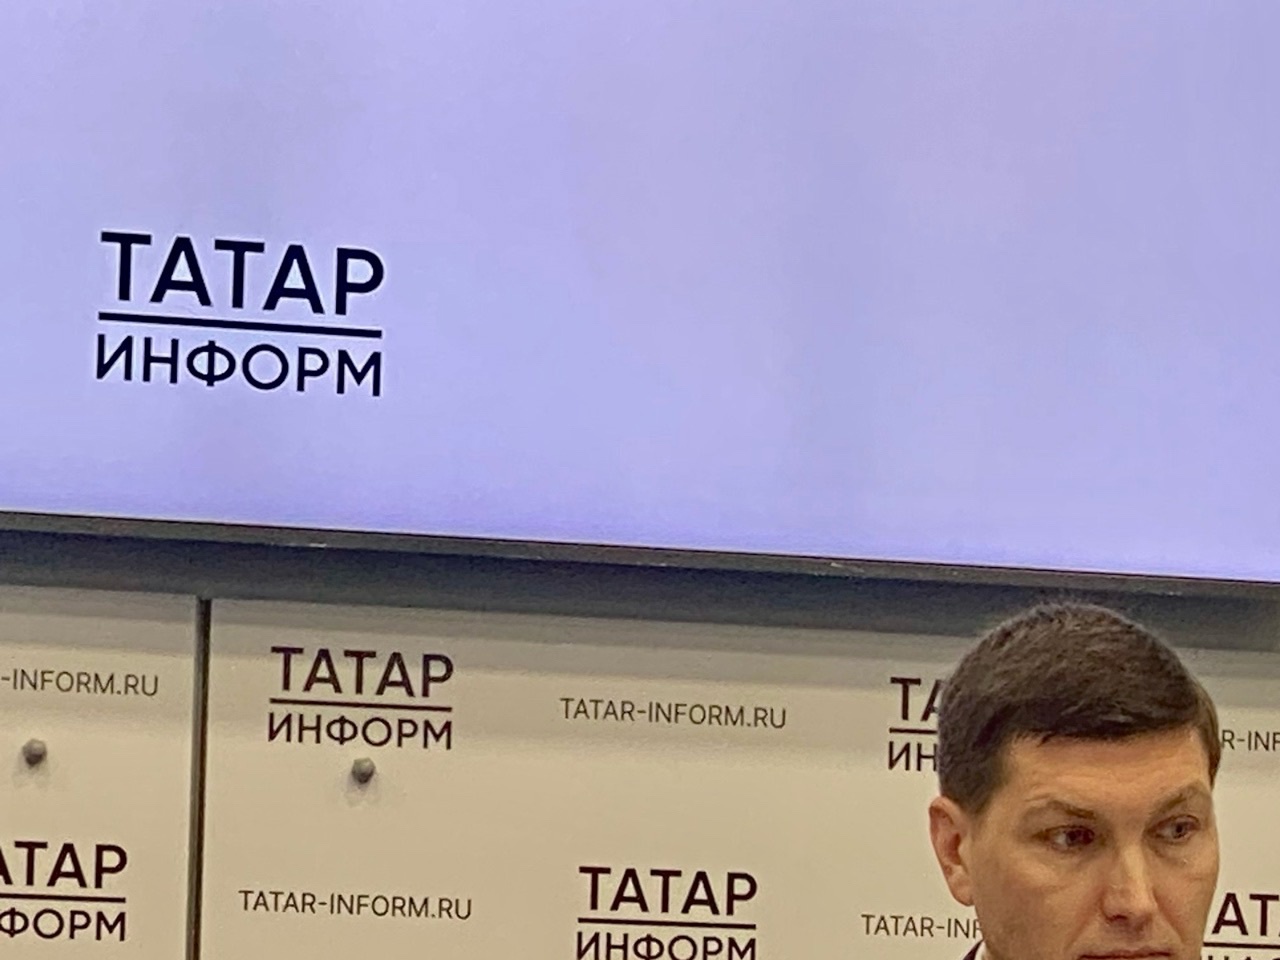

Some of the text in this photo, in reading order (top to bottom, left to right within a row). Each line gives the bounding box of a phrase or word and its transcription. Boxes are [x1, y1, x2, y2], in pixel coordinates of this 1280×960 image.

[101, 231, 384, 315] ТАТАР
[96, 334, 383, 397] ИНФОРМ
[269, 645, 454, 699] ТАТАР
[268, 711, 453, 750] ИНФОРМ
[560, 697, 786, 729] TATAR-INFORM.RU
[238, 890, 472, 920] TATAR-INFORM.RU
[578, 866, 758, 916] ТАТАР
